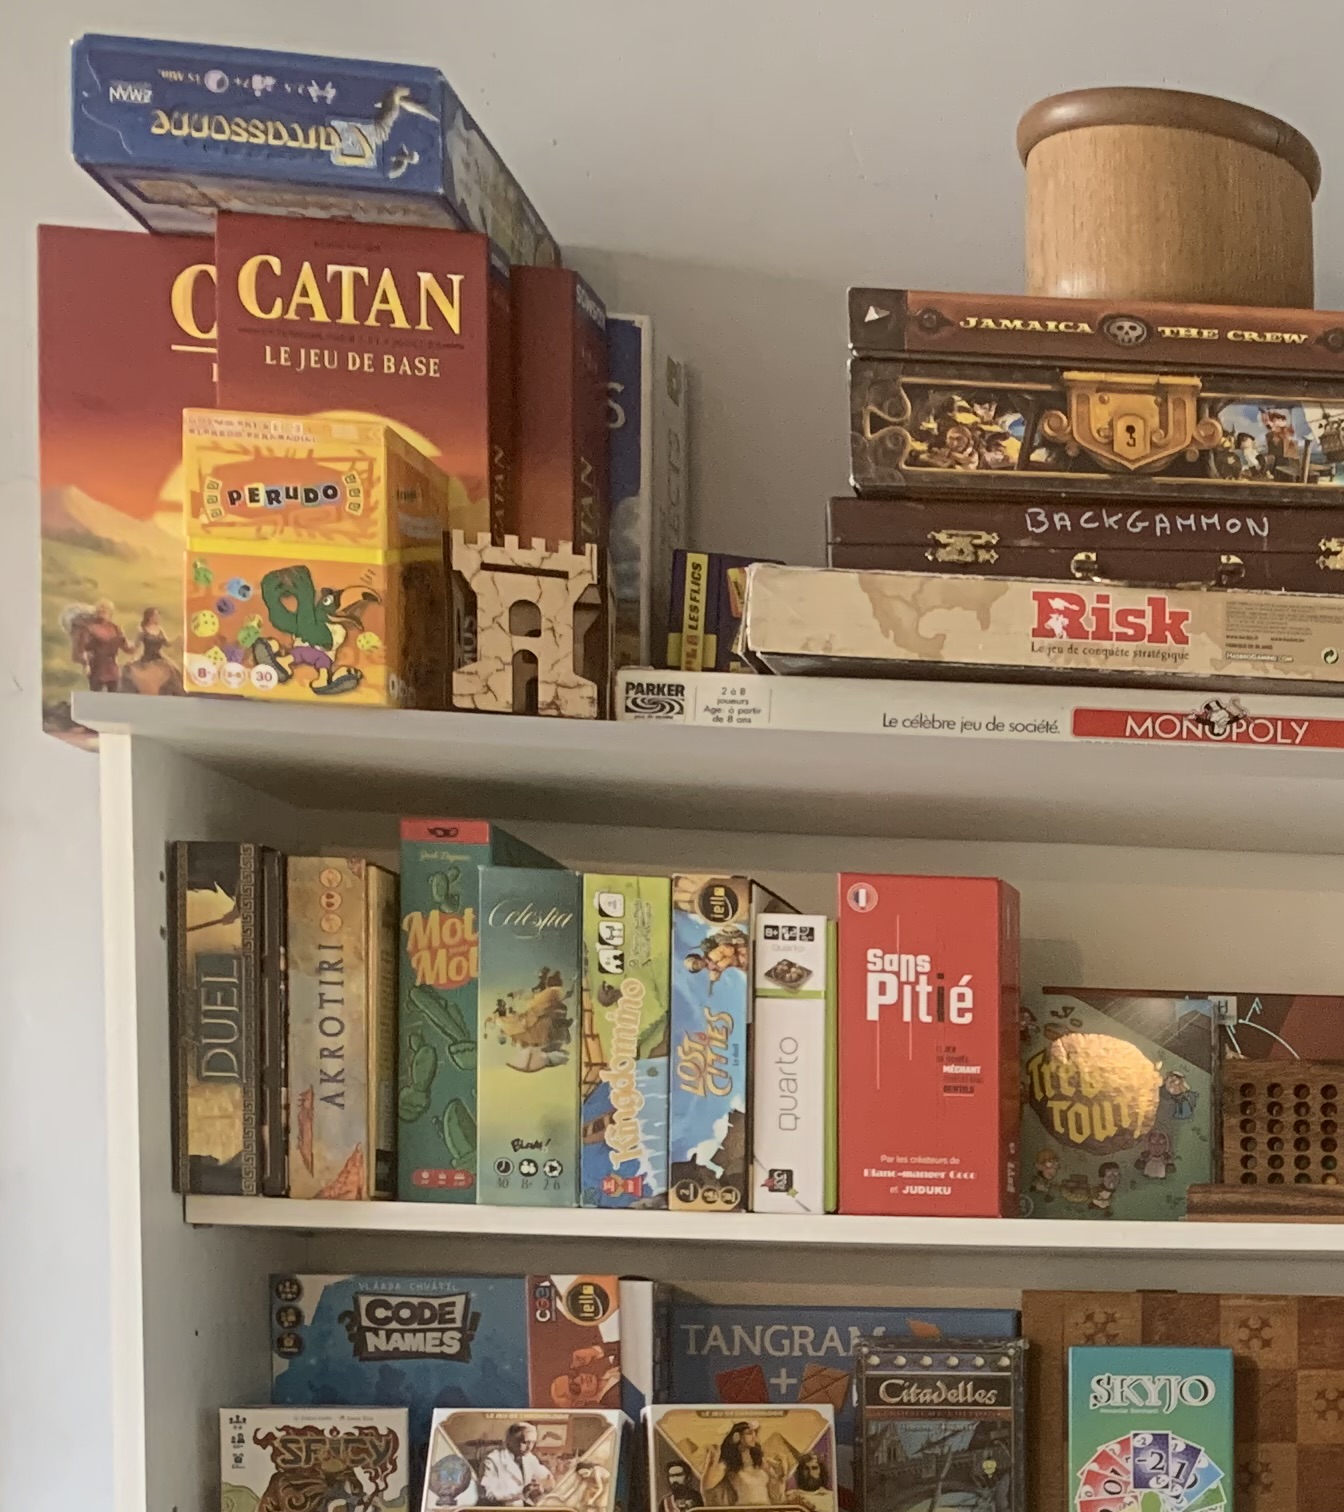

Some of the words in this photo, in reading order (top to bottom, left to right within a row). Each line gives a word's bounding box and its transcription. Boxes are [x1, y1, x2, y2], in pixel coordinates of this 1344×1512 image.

[151, 109, 377, 168] Carcassonne
[238, 254, 465, 335] CATAN
[960, 316, 1095, 335] JAMAICA
[1158, 325, 1221, 341] THE
[1227, 329, 1309, 346] CREW
[265, 346, 291, 365] LE
[296, 348, 338, 372] JEU
[348, 354, 375, 372] DE
[383, 357, 441, 378] BASE
[228, 484, 339, 507] PERUDO
[1025, 507, 1271, 538] BACKGAMMON
[690, 562, 702, 603] FLICS
[688, 604, 699, 631] LES
[1031, 591, 1190, 646] Risk
[1031, 643, 1043, 653] Le
[1047, 644, 1064, 657] jeu
[1067, 644, 1079, 655] de
[1082, 644, 1130, 659] conquête
[1133, 648, 1189, 664] stratégique
[625, 681, 685, 697] PARKER
[883, 713, 899, 728] Le
[902, 713, 957, 731] célèbre
[960, 715, 982, 733] jeu
[985, 715, 1005, 732] de
[1125, 714, 1309, 745] MONOPOLY
[403, 907, 478, 951] Mot
[488, 901, 573, 930] Celestia
[867, 948, 931, 982] Sans
[866, 972, 973, 1025] Pitié
[202, 959, 240, 1079] DUEL
[319, 943, 345, 1109] AKROTIRI
[676, 1029, 707, 1096] LOST
[701, 1006, 734, 1097] CITIES
[601, 978, 646, 1170] Kingdomino
[881, 1155, 893, 1164] Par
[896, 1155, 908, 1164] les
[950, 1156, 960, 1165] de
[902, 1184, 952, 1196] JUDUKU
[365, 1298, 457, 1327] CODE
[366, 1330, 462, 1355] NAMES
[878, 1378, 998, 1405] Citadelles
[1089, 1373, 1217, 1414] SKYJO
